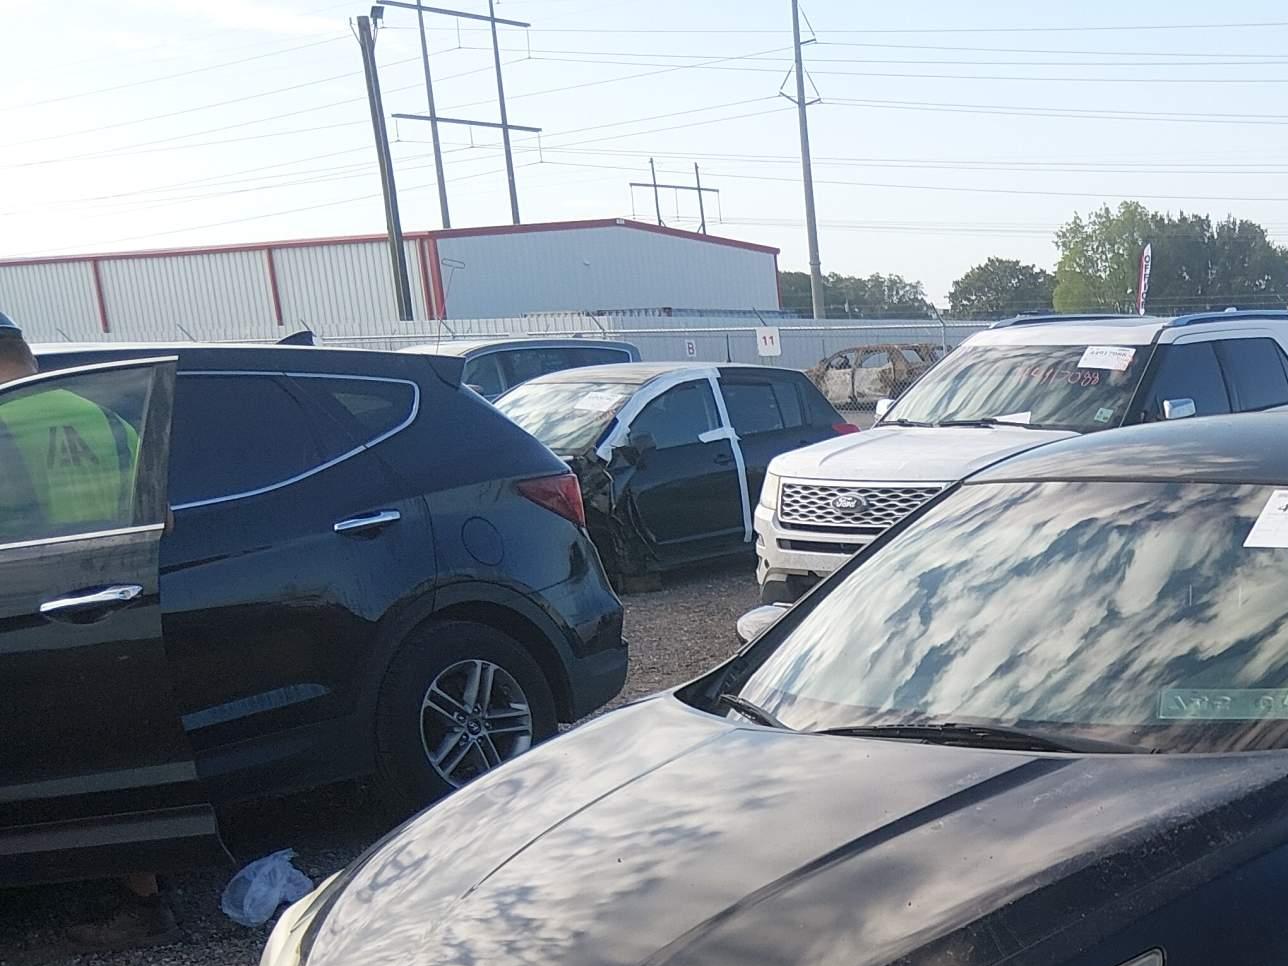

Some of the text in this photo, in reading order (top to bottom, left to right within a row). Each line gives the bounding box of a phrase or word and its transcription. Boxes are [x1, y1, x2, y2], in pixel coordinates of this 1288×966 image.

[762, 335, 775, 346] 11
[687, 342, 695, 355] B
[836, 497, 858, 508] Ford
